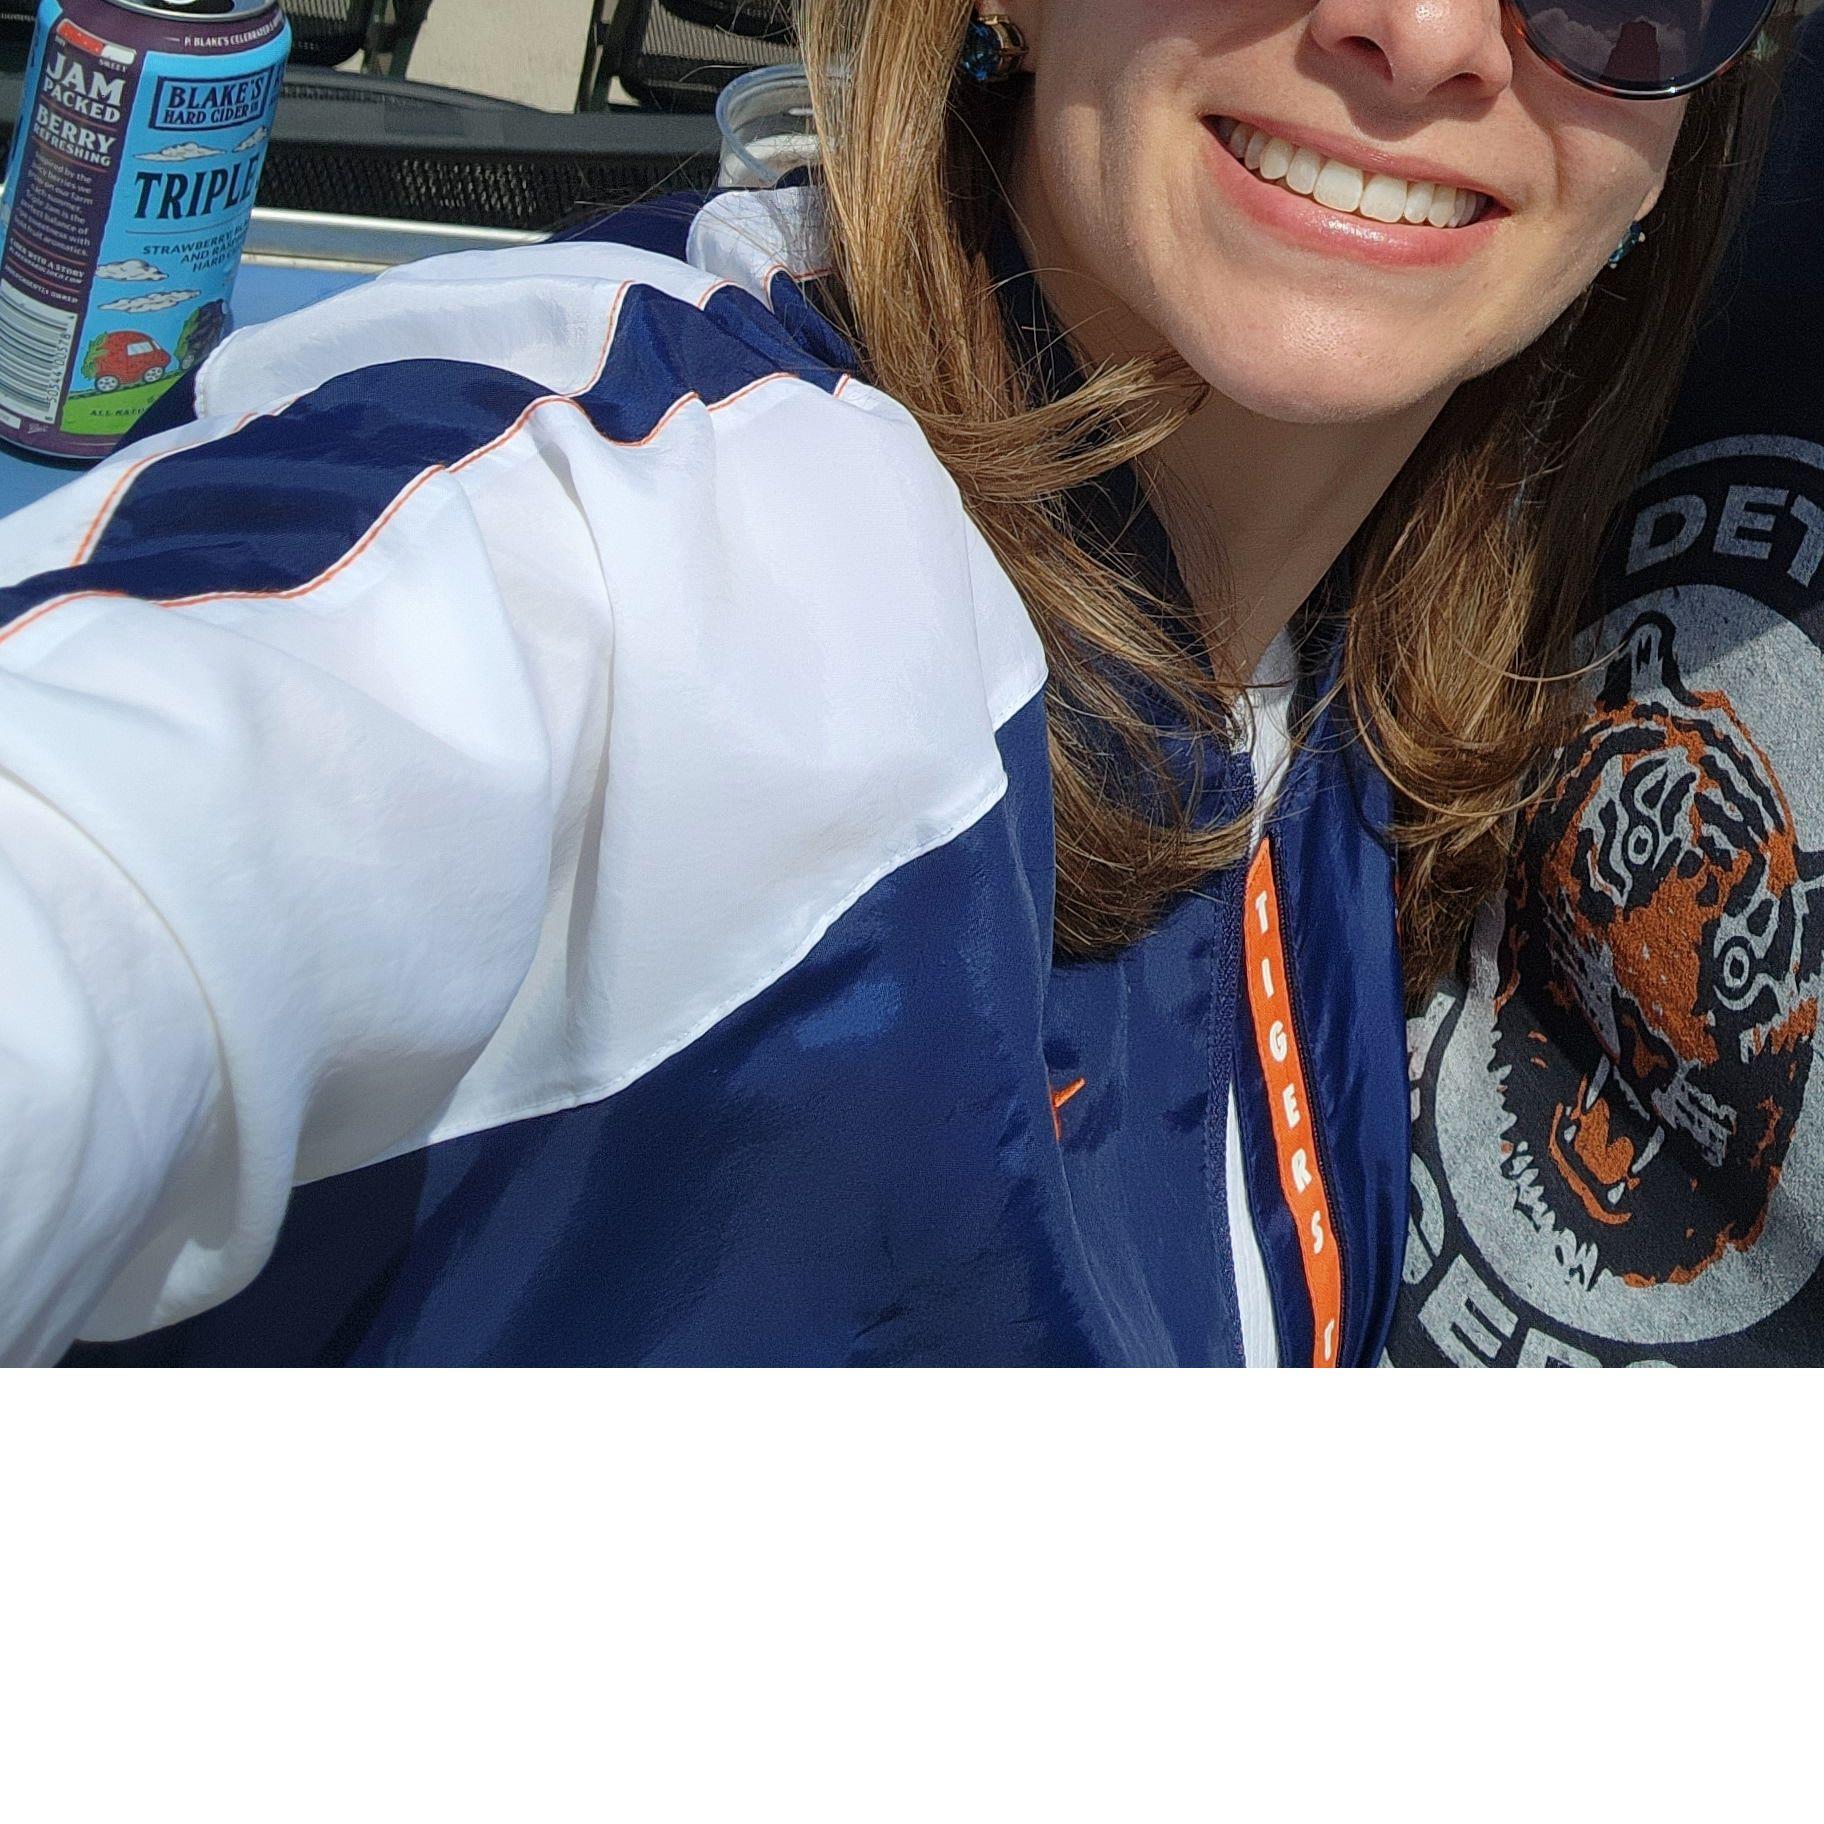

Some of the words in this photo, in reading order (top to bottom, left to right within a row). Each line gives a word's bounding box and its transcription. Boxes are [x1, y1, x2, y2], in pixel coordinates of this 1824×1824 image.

[43, 76, 121, 123] PACKED
[46, 52, 126, 107] JAM
[168, 77, 265, 109] BLAKE'S
[36, 103, 117, 154] BERRY
[163, 109, 207, 126] HARD
[211, 102, 250, 124] CIDER
[33, 123, 112, 167] REFRESHING
[135, 153, 259, 220] TRIPLE
[180, 250, 209, 265] AND
[192, 253, 225, 273] HARD
[1255, 890, 1324, 1256] TIGERS
